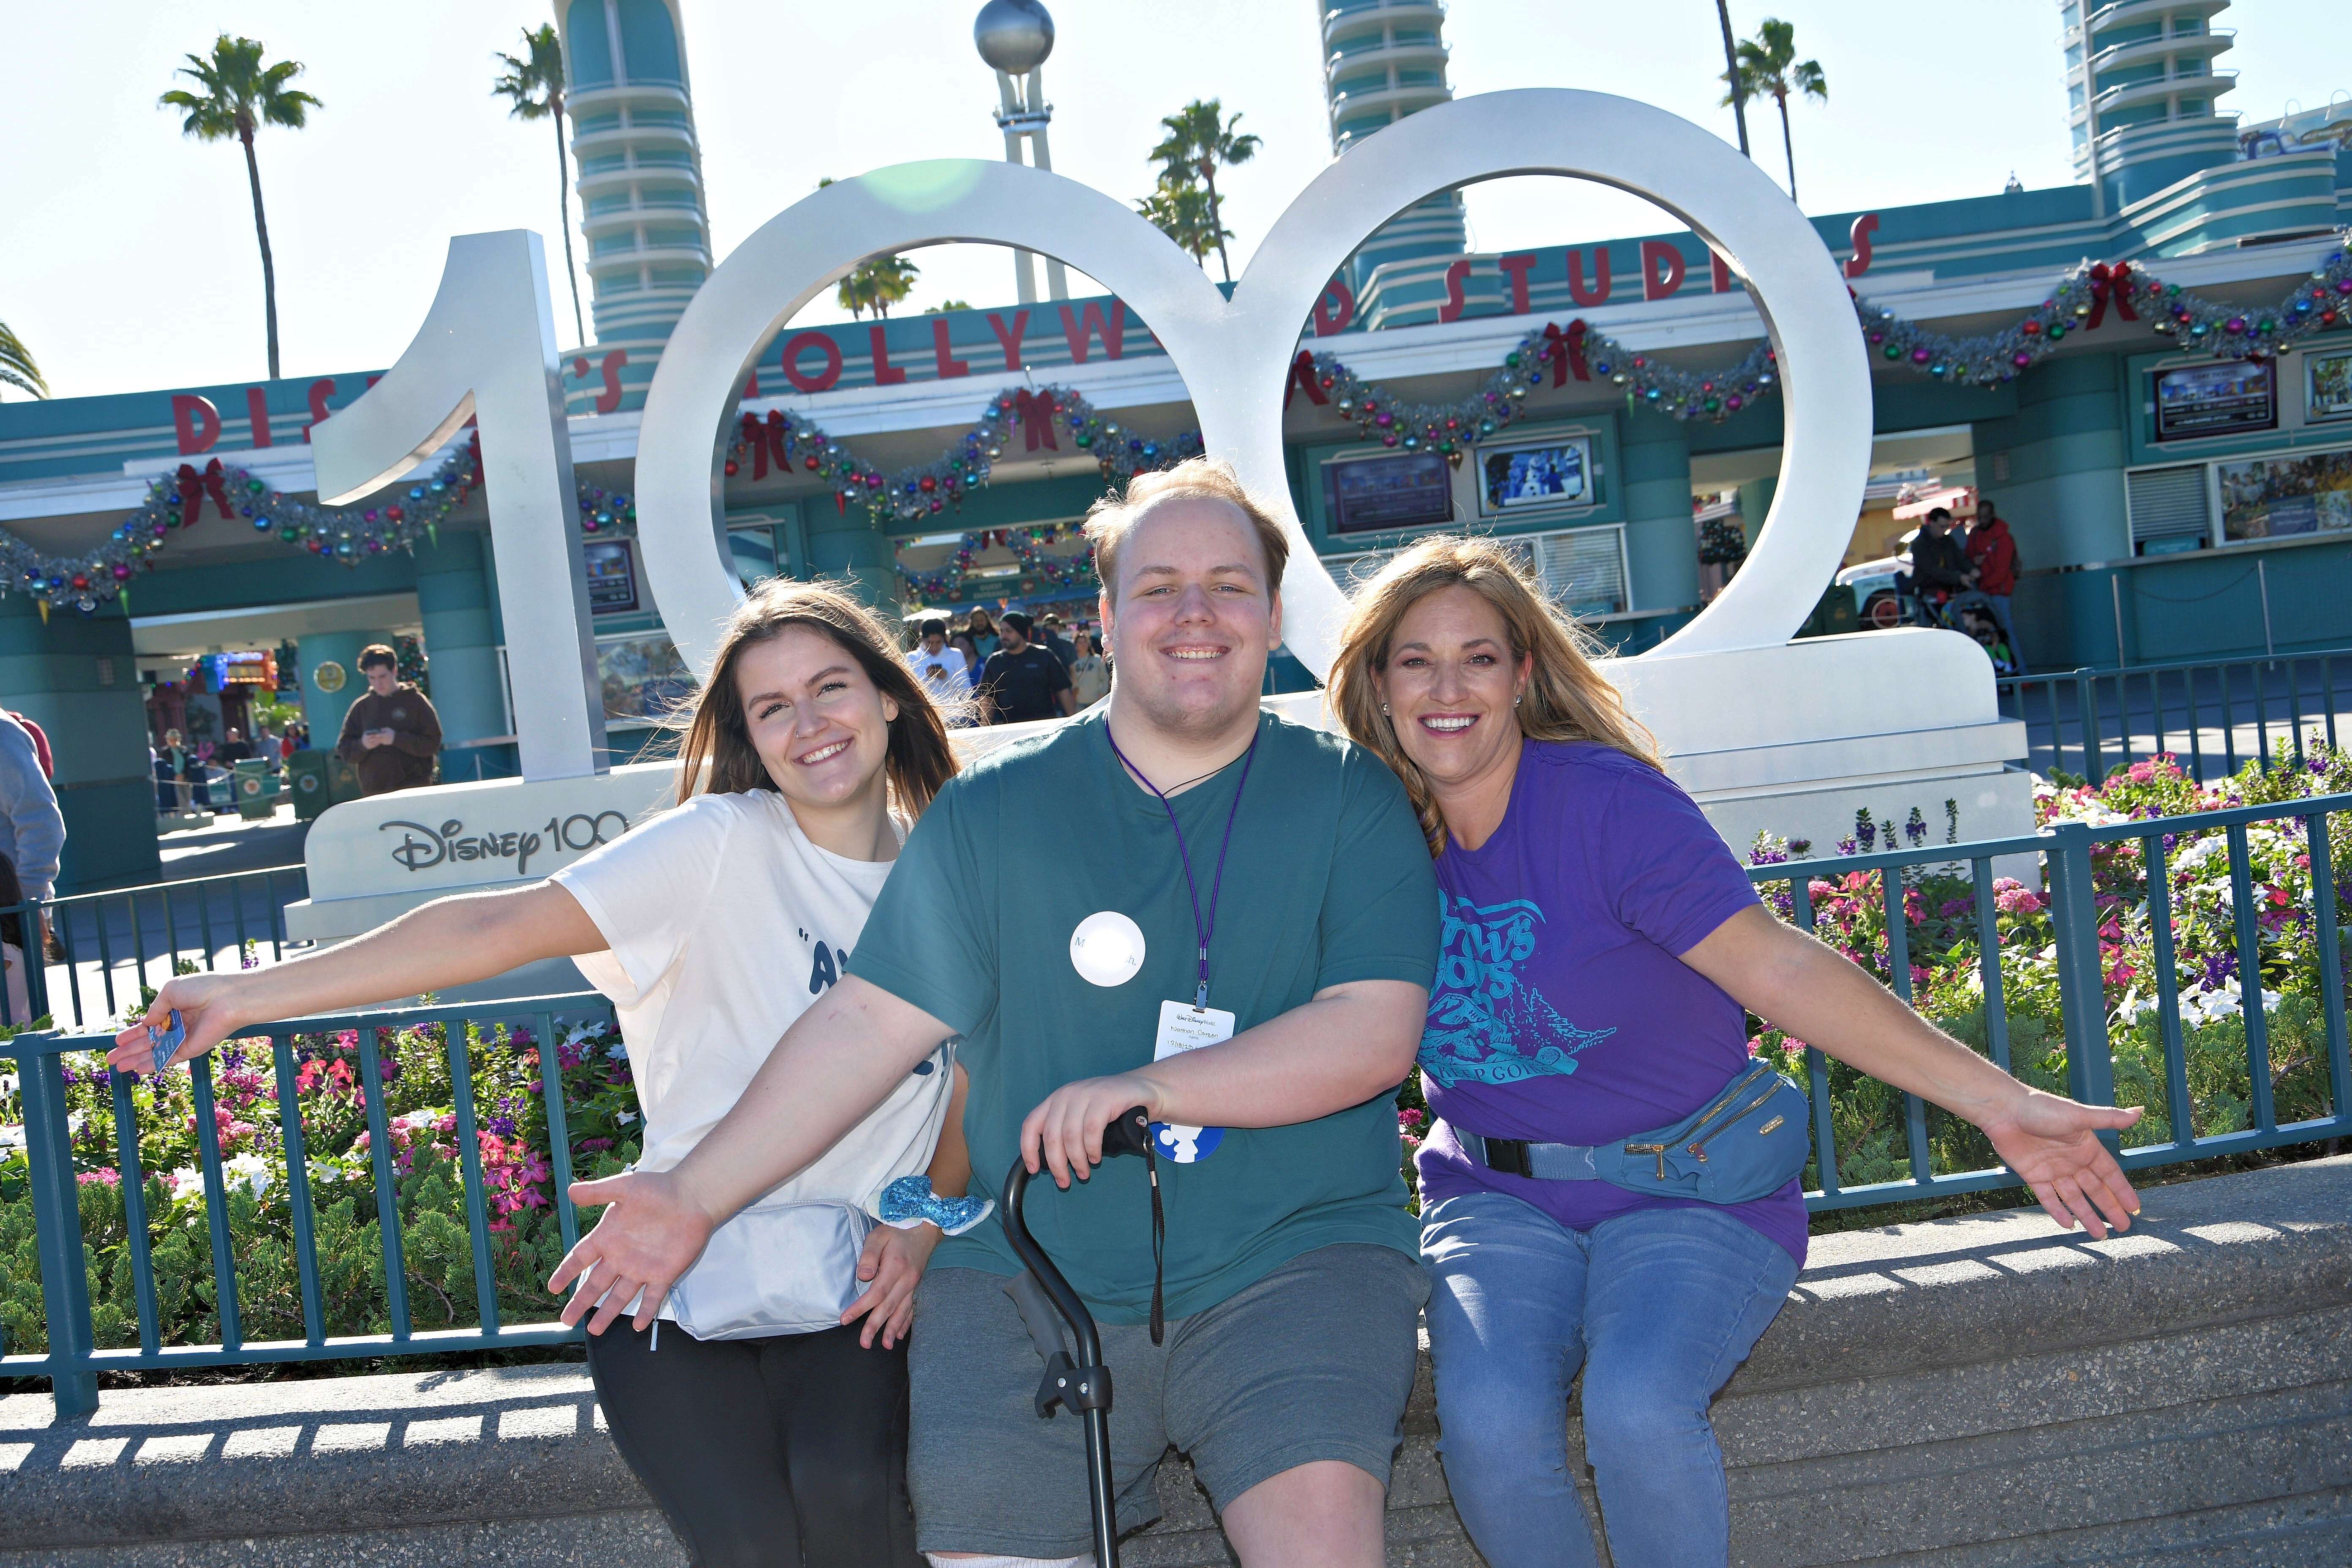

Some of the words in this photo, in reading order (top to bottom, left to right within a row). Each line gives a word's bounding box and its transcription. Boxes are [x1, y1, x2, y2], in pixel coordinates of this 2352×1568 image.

[171, 349, 628, 455] DIS'S
[743, 279, 1355, 398] OLLYWD
[1437, 213, 1879, 324] STUDIS
[378, 819, 541, 874] Disney
[544, 810, 630, 851] 100
[1186, 1015, 1204, 1026] Disney
[1171, 1026, 1195, 1034] Nathan
[1437, 1067, 1485, 1081] KEEP
[1492, 1064, 1554, 1080] GOING
